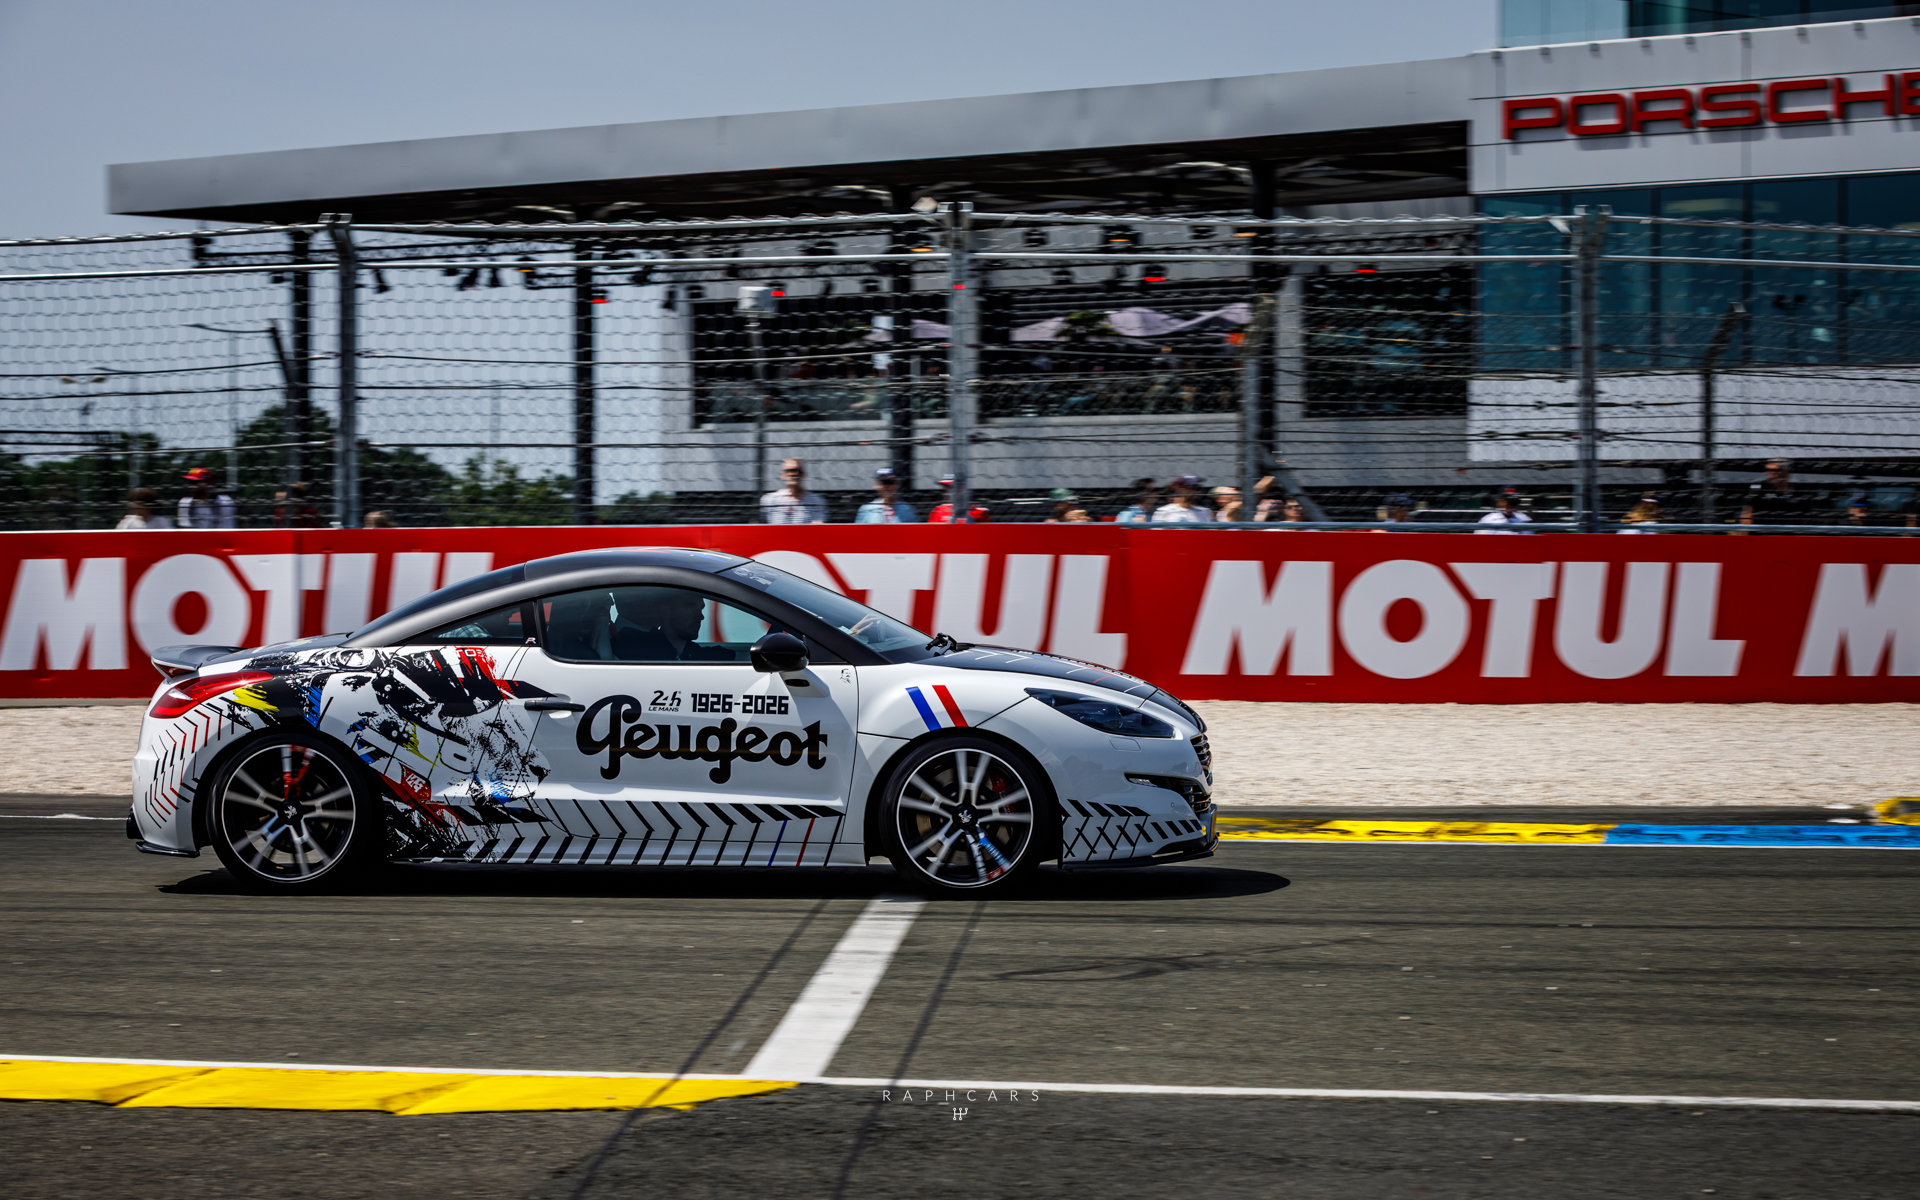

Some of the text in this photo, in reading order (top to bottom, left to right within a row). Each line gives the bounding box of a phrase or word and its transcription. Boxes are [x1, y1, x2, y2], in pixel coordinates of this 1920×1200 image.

[0, 553, 496, 672] MOTU
[1179, 559, 1746, 680] MOTUL
[575, 694, 828, 785] Peugeot
[691, 693, 790, 716] 1926-2026
